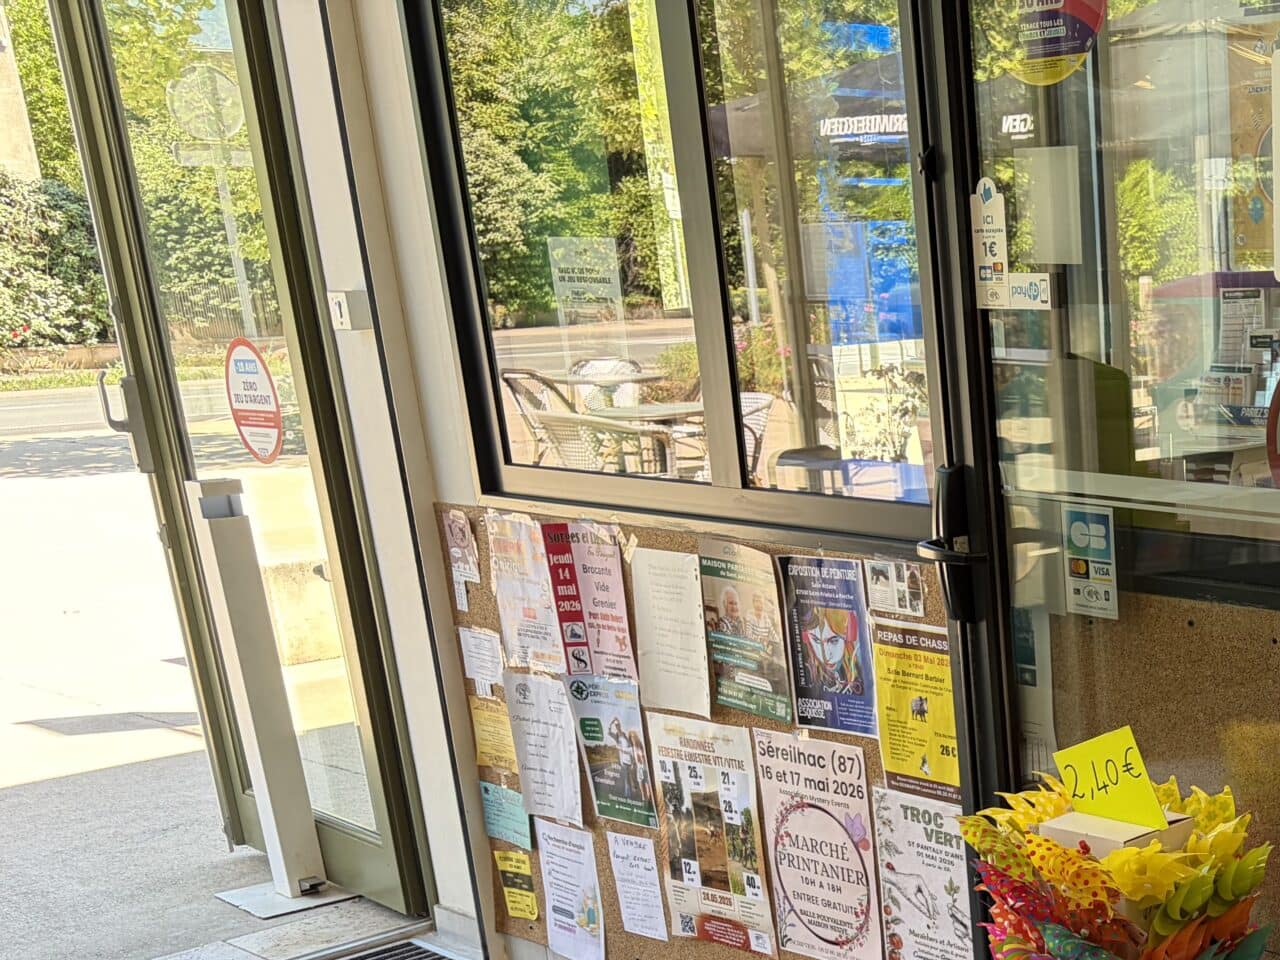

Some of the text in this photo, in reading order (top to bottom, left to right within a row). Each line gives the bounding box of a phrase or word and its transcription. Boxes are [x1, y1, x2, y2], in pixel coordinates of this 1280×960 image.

[982, 215, 994, 225] ICI
[981, 241, 997, 258] 1€
[242, 380, 258, 392] ZÉRO
[549, 553, 573, 566] Jeudi
[558, 567, 571, 580] 14
[582, 563, 612, 577] Brocante
[1093, 565, 1111, 578] VISA
[558, 583, 577, 596] mai
[594, 581, 610, 593] Vide
[558, 600, 581, 612] 2026
[592, 597, 616, 610] Grenier
[877, 630, 949, 651] REPAS DE CHASS
[878, 647, 912, 661] Dimanche
[923, 654, 936, 665] Mai
[901, 669, 924, 681] Bernard
[924, 673, 945, 684] Barbier
[798, 697, 833, 711] ASSOCIATION
[799, 706, 826, 720] ESQUISSE
[679, 736, 716, 754] RANDONNÉES
[940, 744, 951, 757] 26
[758, 741, 862, 780] Séreilhac (87)
[721, 771, 730, 785] 21
[760, 764, 773, 780] 16
[776, 769, 788, 784] et
[790, 770, 801, 787] 17
[804, 777, 829, 793] mai
[833, 780, 864, 800] 2026
[900, 803, 944, 830] TROC
[923, 826, 963, 850] VERT
[789, 834, 849, 862] MARCHÉ
[683, 861, 692, 875] 12
[777, 850, 866, 887] PRINTANIER
[746, 876, 756, 890] 40
